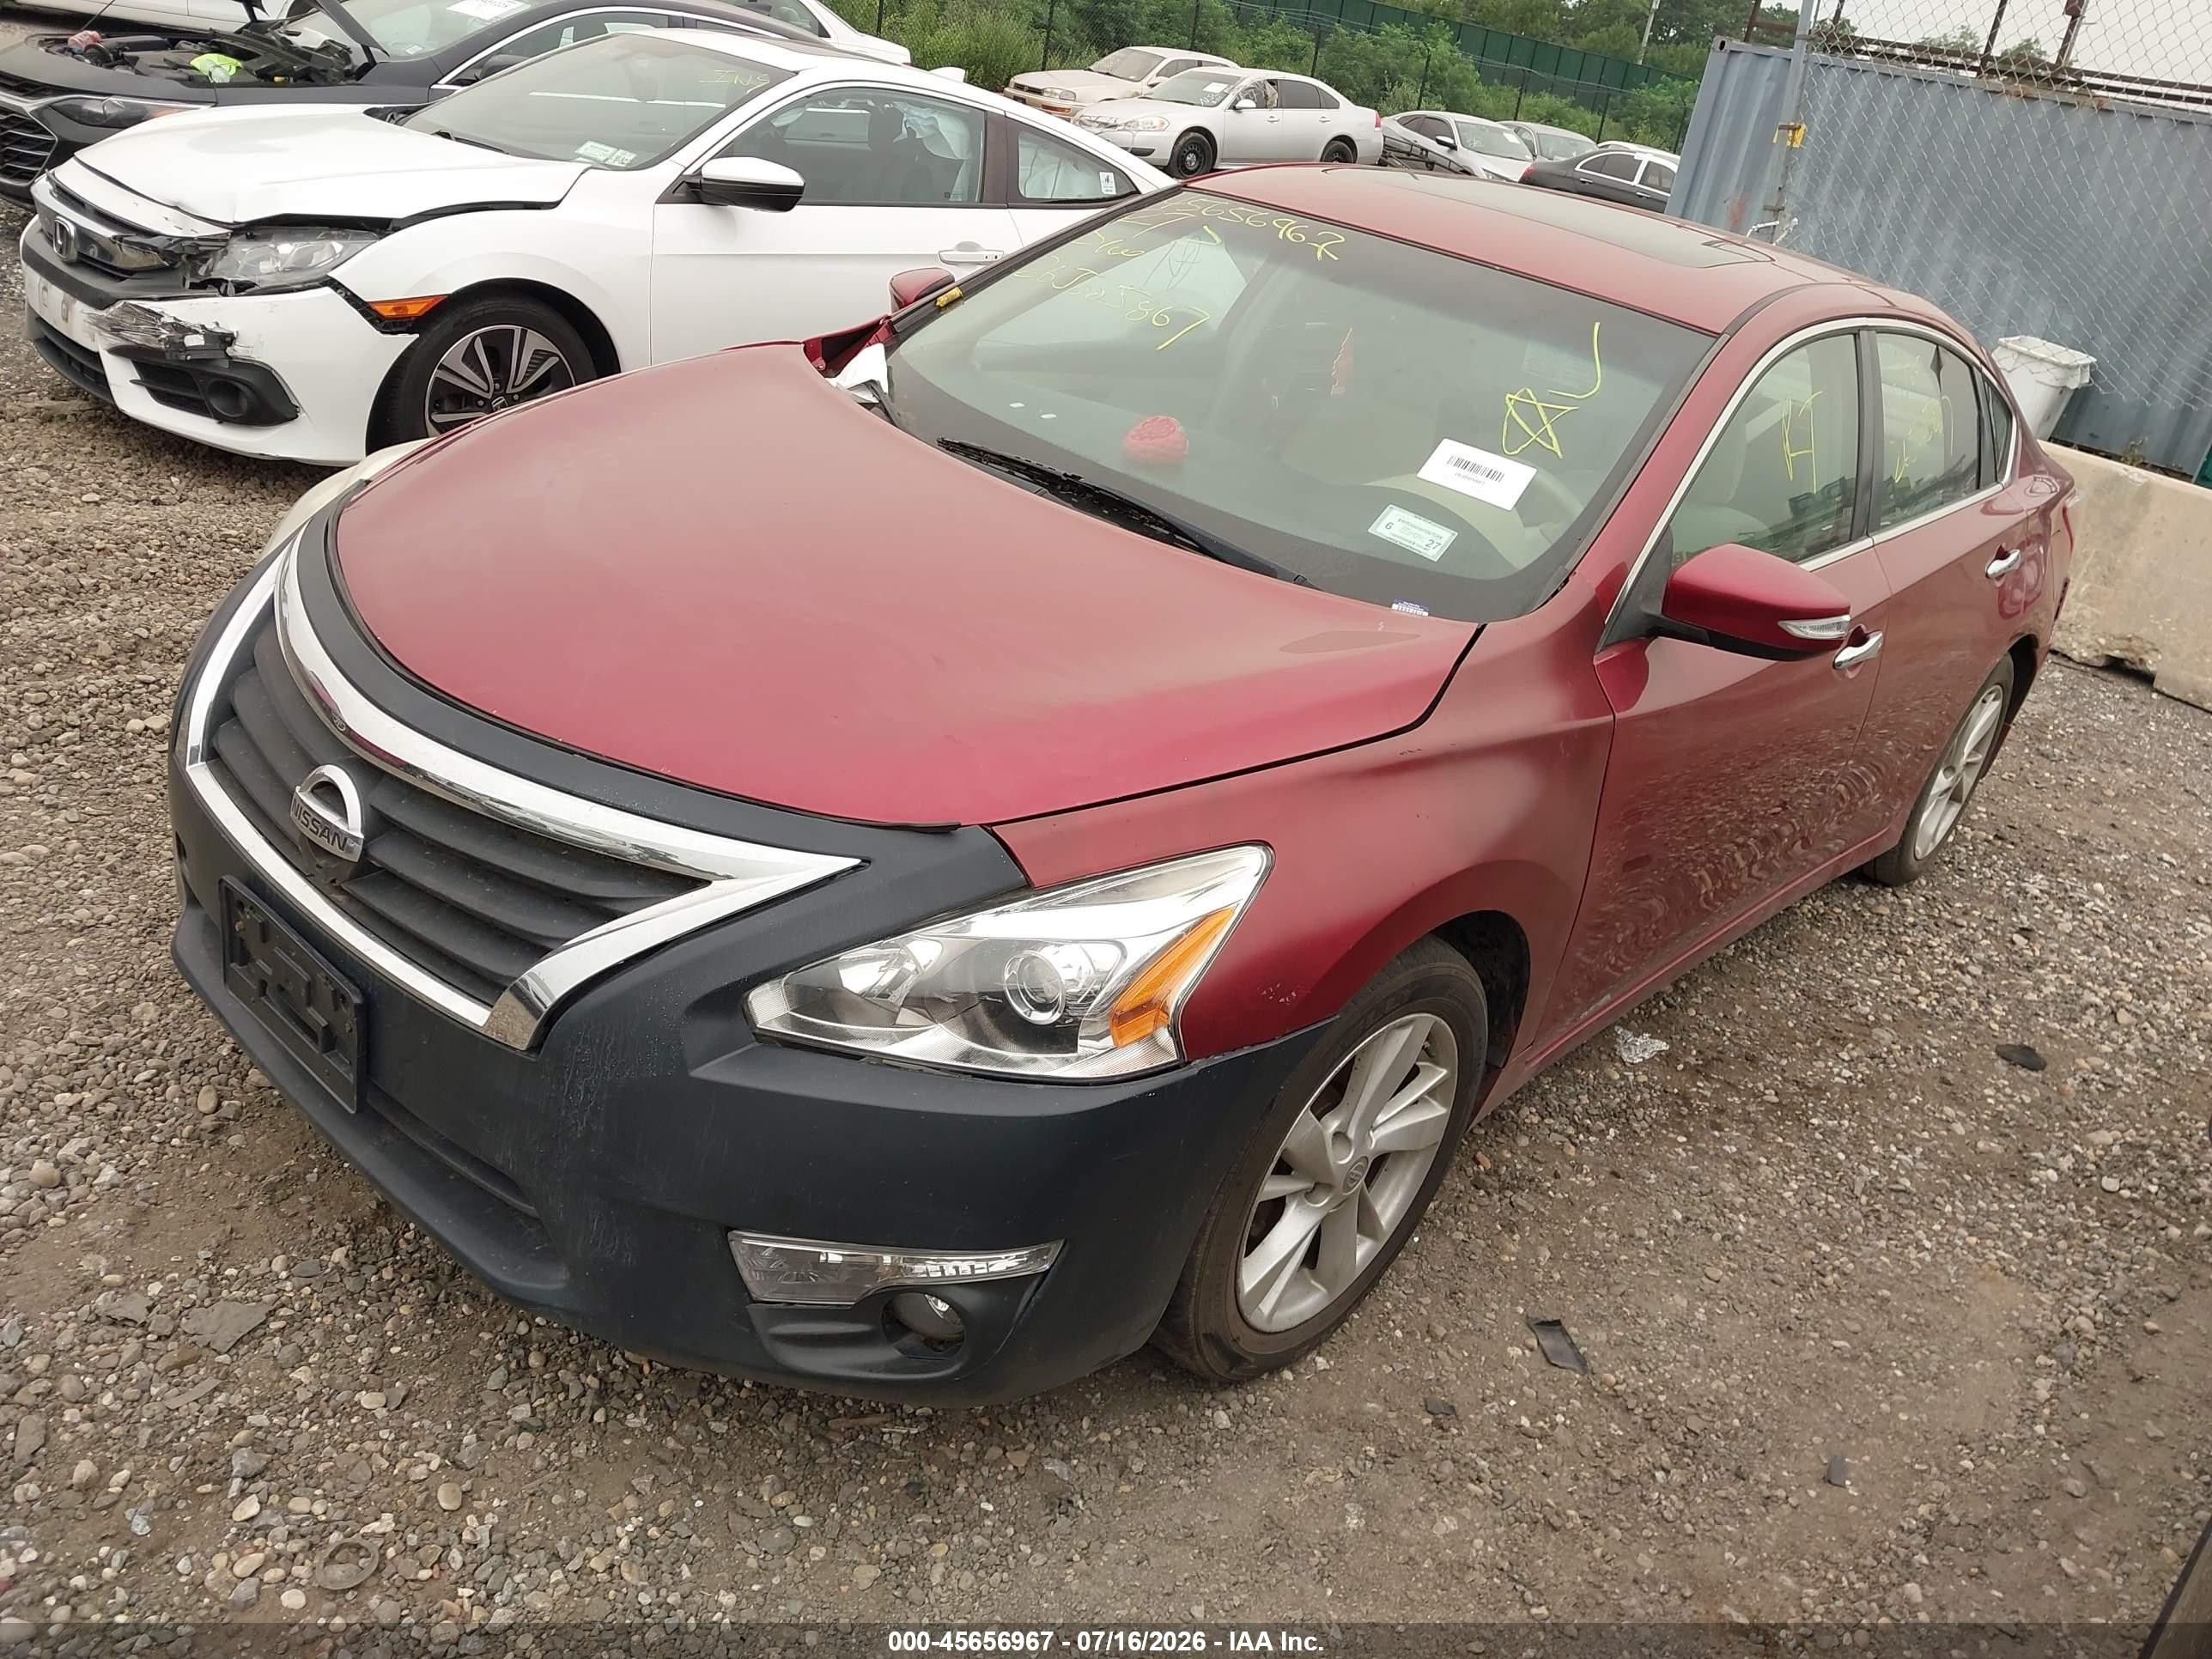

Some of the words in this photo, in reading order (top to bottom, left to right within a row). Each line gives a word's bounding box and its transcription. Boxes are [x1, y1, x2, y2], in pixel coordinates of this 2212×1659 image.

[1384, 521, 1395, 530] 6
[1425, 538, 1443, 550] 27
[292, 801, 347, 852] NISSAN
